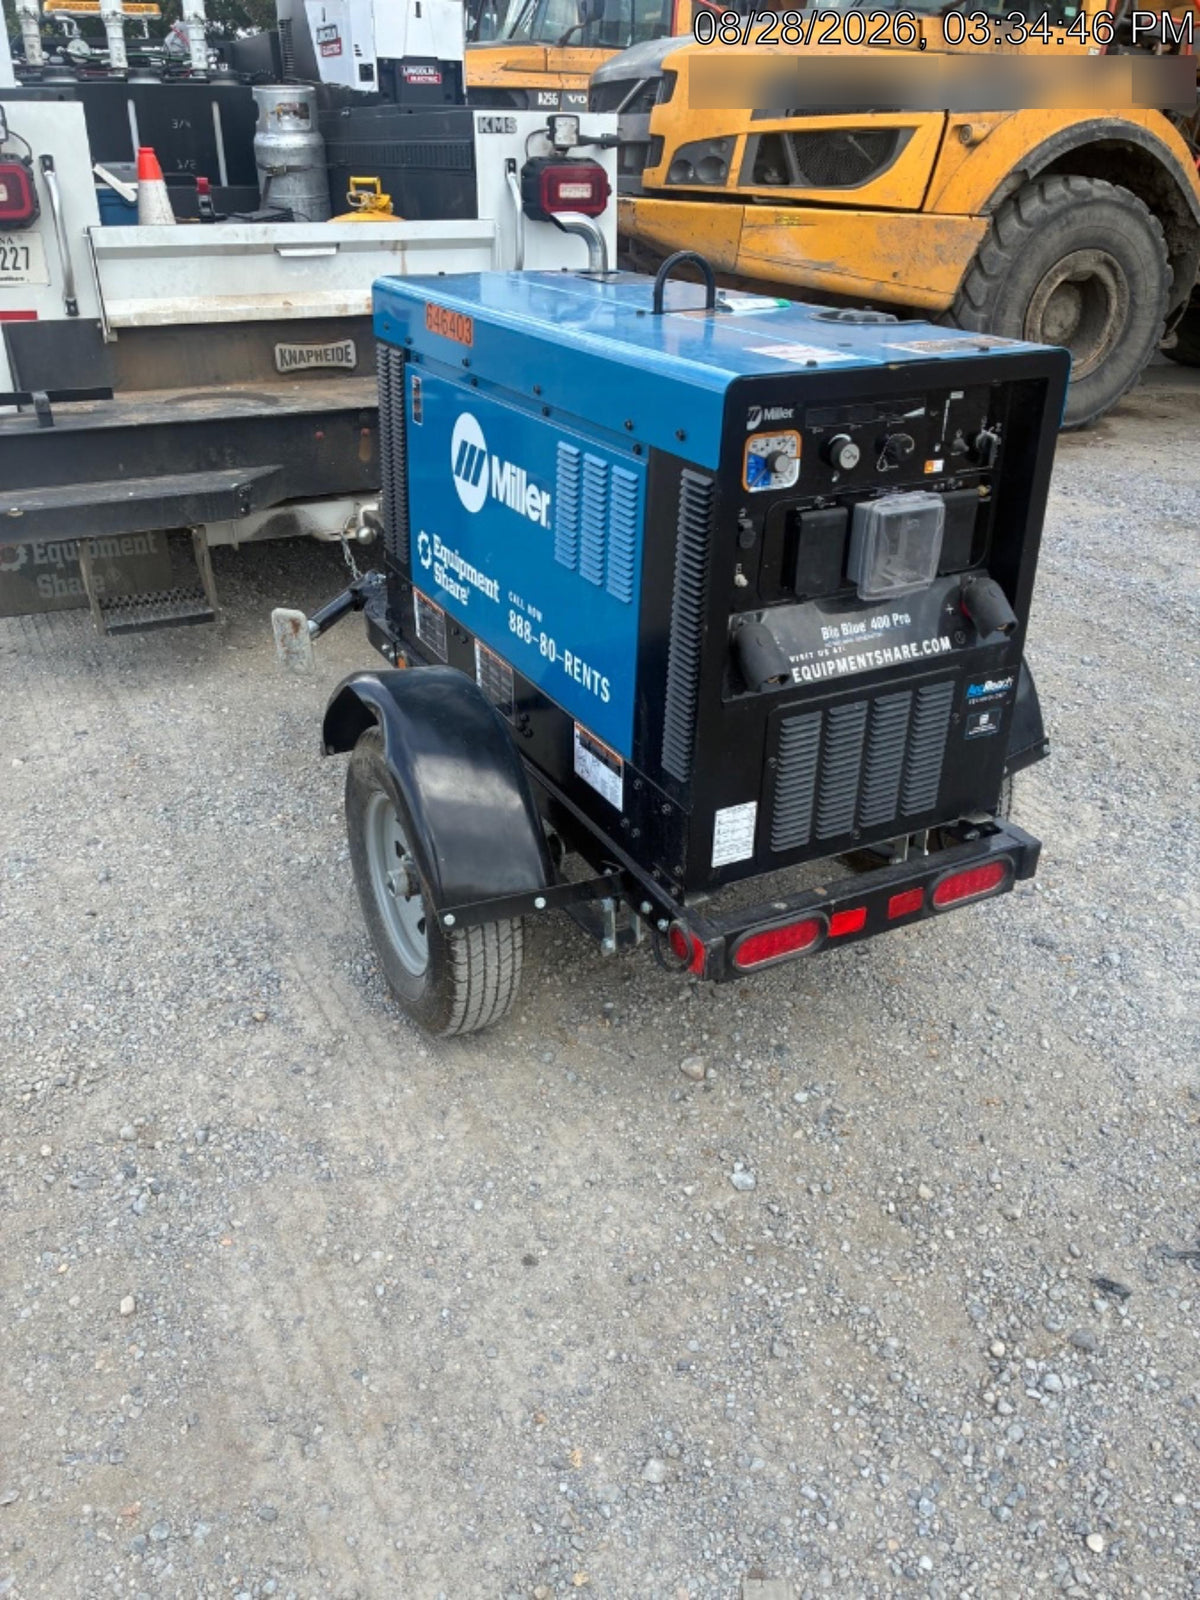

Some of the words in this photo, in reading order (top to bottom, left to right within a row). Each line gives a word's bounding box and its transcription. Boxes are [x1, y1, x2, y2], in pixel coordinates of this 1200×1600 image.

[478, 117, 517, 134] KMS
[426, 303, 473, 344] 646403
[279, 343, 353, 367] KNAPHEIDE
[763, 407, 794, 420] Miller
[491, 454, 551, 528] Miller
[36, 573, 106, 599] Shae
[433, 534, 500, 604] Equipment
[434, 562, 470, 606] Share
[508, 591, 525, 611] CALL
[527, 603, 543, 623] NOW
[508, 609, 611, 704] 888-80-RENTS
[792, 636, 952, 683] EQUIPMENTSHARE.COM
